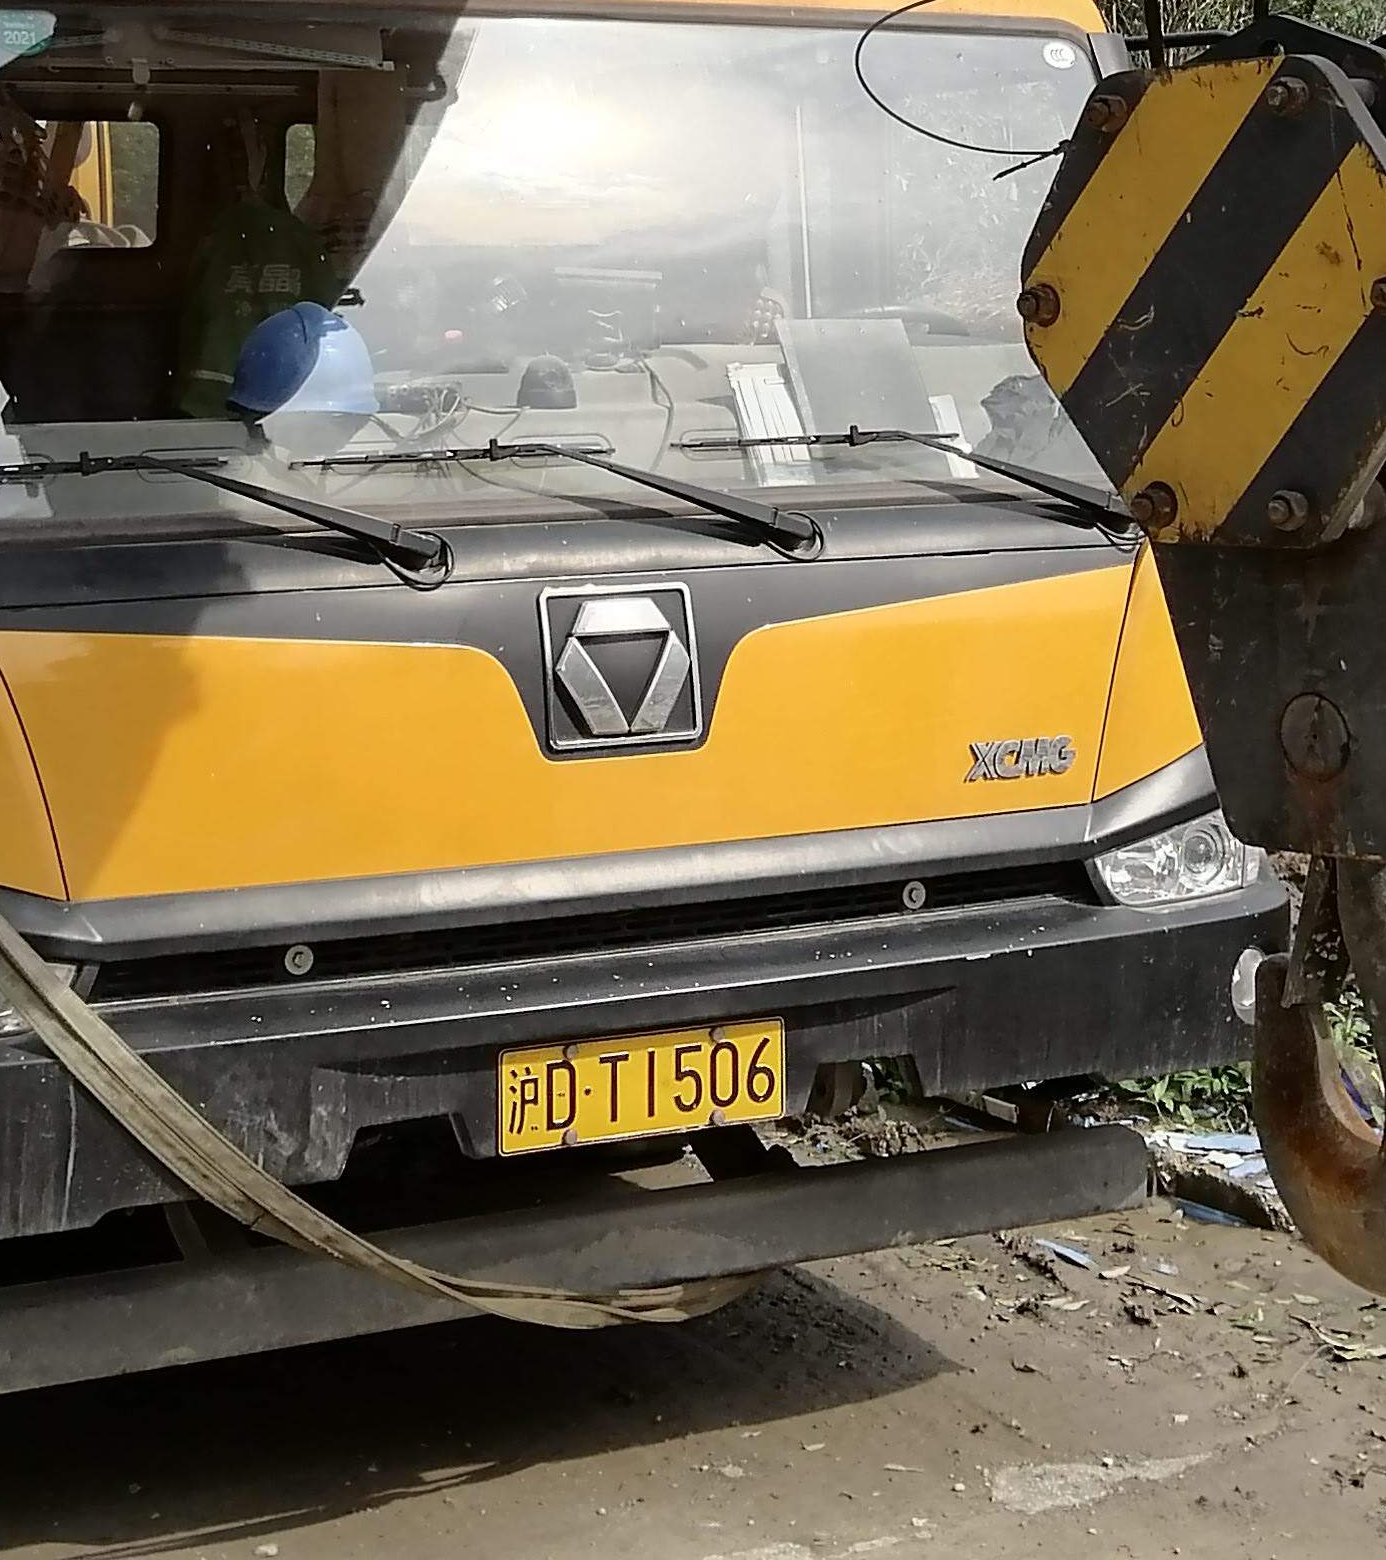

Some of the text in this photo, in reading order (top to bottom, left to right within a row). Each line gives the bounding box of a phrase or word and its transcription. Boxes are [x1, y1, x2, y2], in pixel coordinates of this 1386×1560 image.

[3, 30, 37, 44] 2021
[964, 735, 1077, 783] XCMG
[509, 1037, 775, 1134] 沪D·T1506
